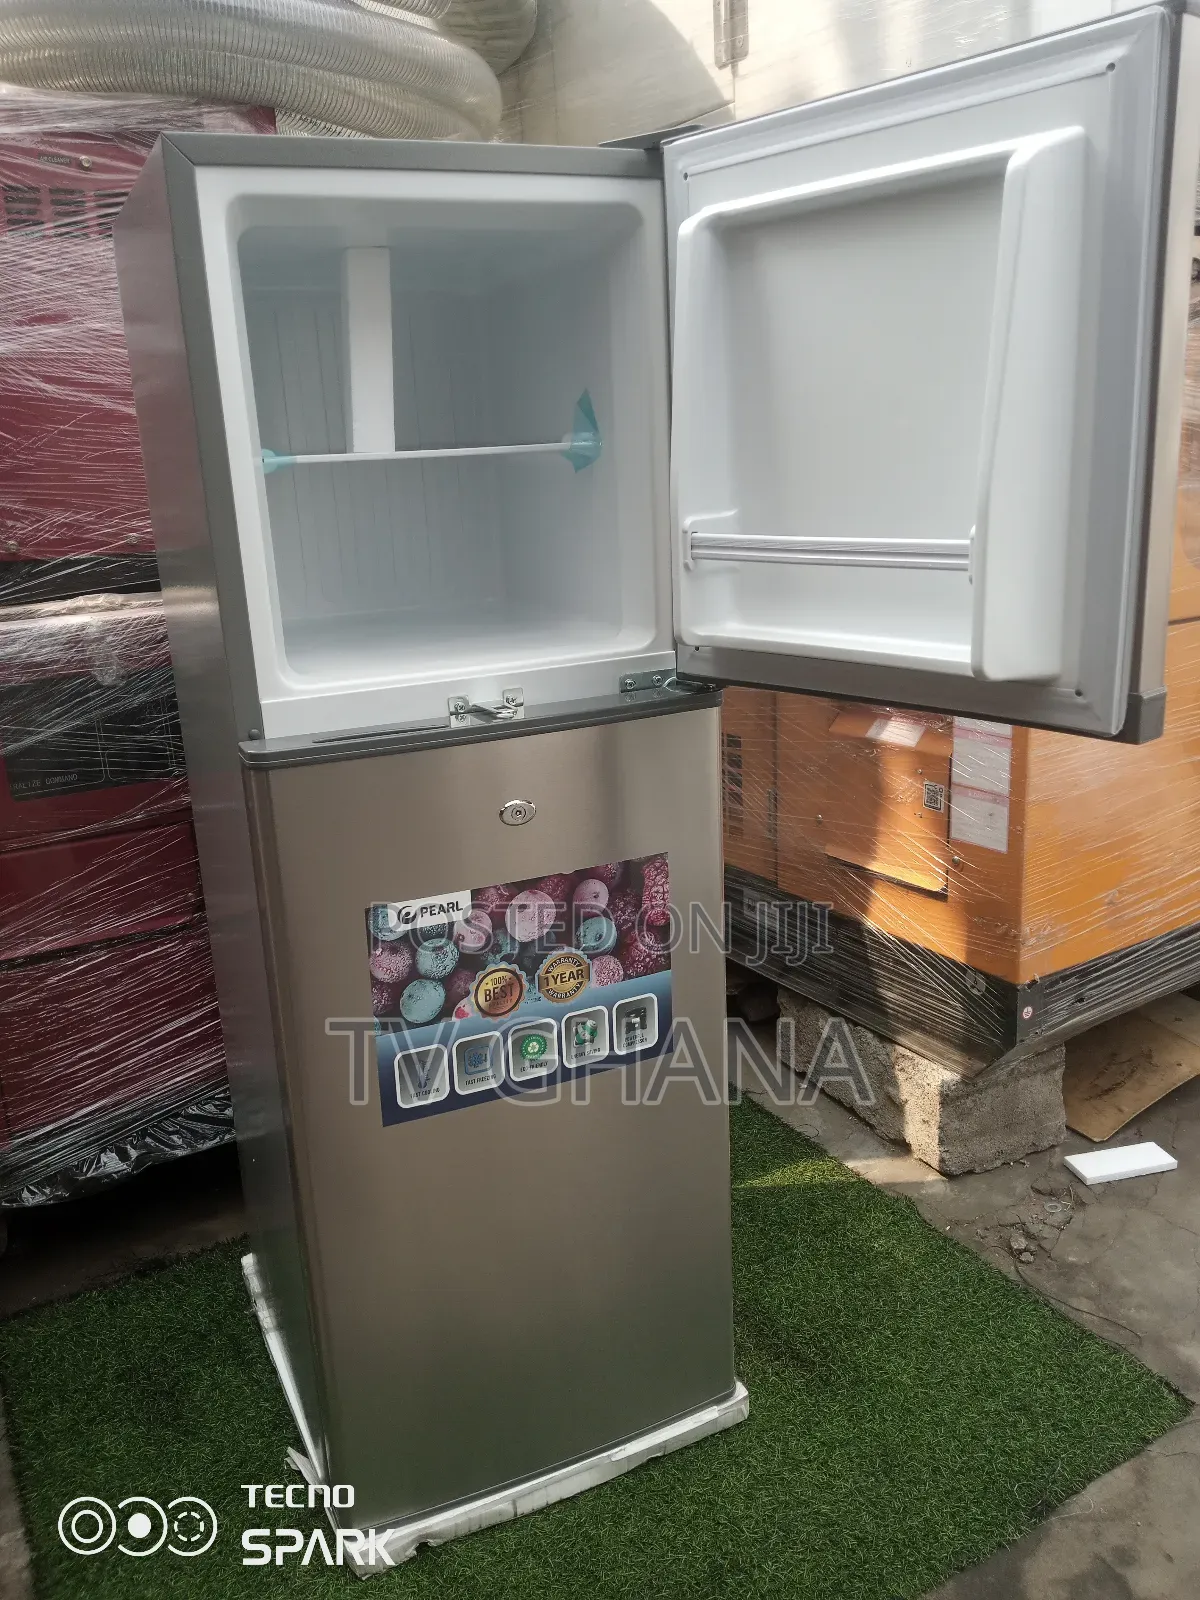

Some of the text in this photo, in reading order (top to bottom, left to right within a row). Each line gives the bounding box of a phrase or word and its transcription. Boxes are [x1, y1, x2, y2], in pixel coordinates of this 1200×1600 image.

[45, 773, 78, 785] COMMAND
[420, 901, 463, 918] PEARL
[548, 957, 581, 972] WARRANTY
[490, 975, 508, 986] 100%
[543, 968, 585, 987] 1 YEAR
[484, 982, 514, 1002] BEST
[548, 982, 581, 999] WARRANTY
